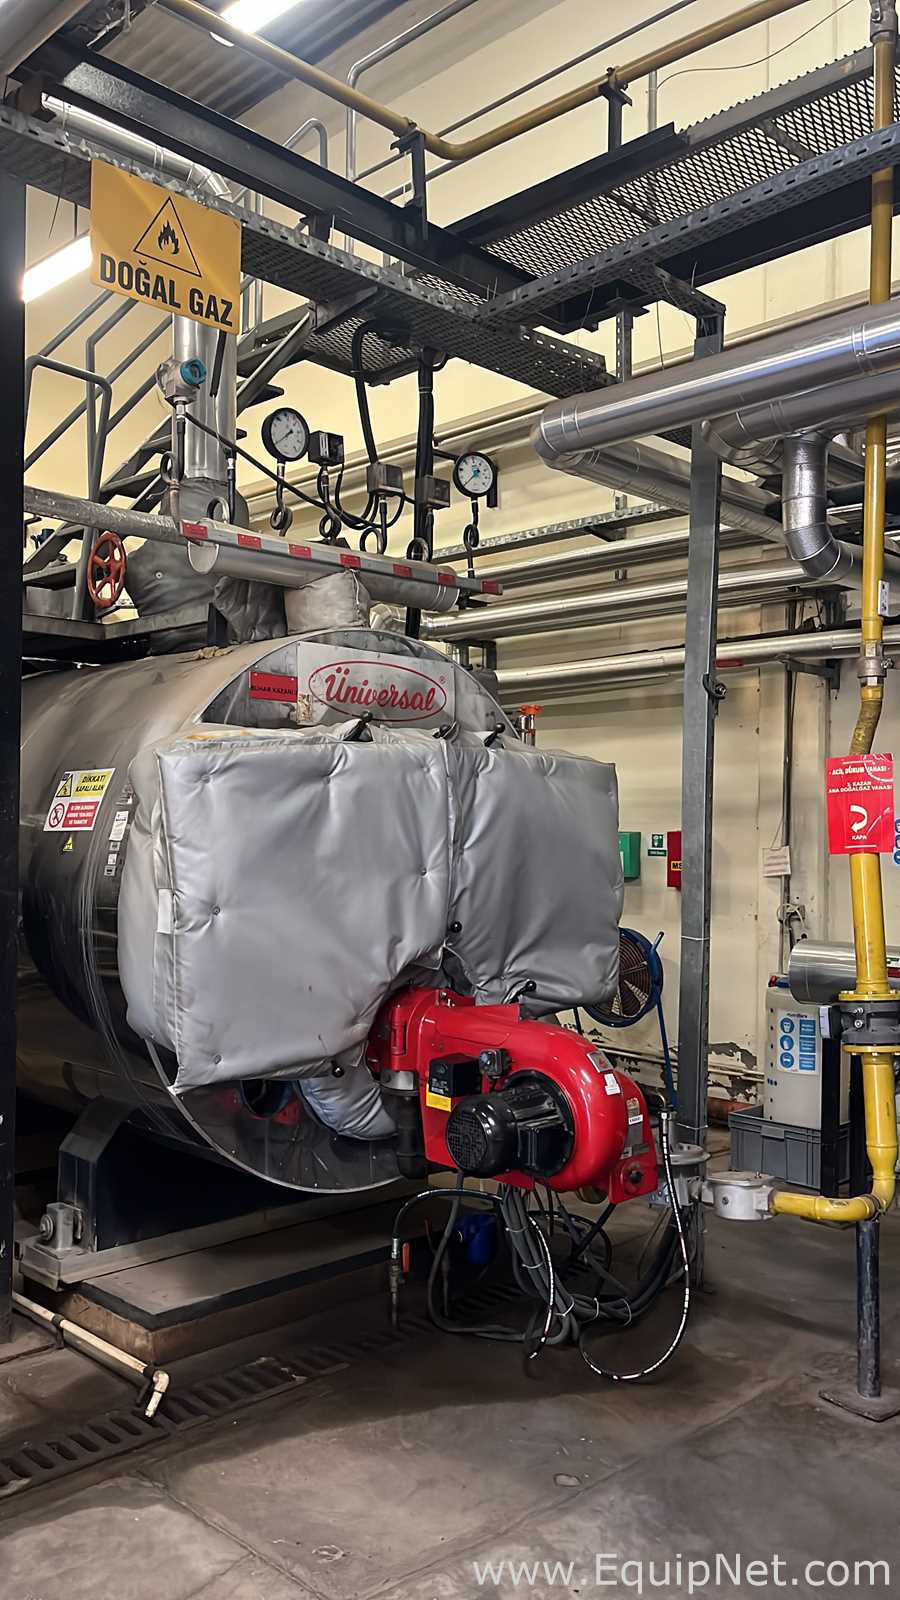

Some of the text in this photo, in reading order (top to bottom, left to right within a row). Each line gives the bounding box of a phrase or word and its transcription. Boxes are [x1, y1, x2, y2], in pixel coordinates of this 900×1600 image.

[100, 253, 232, 327] DOĞAL GAZ
[325, 666, 436, 711] Üniversal
